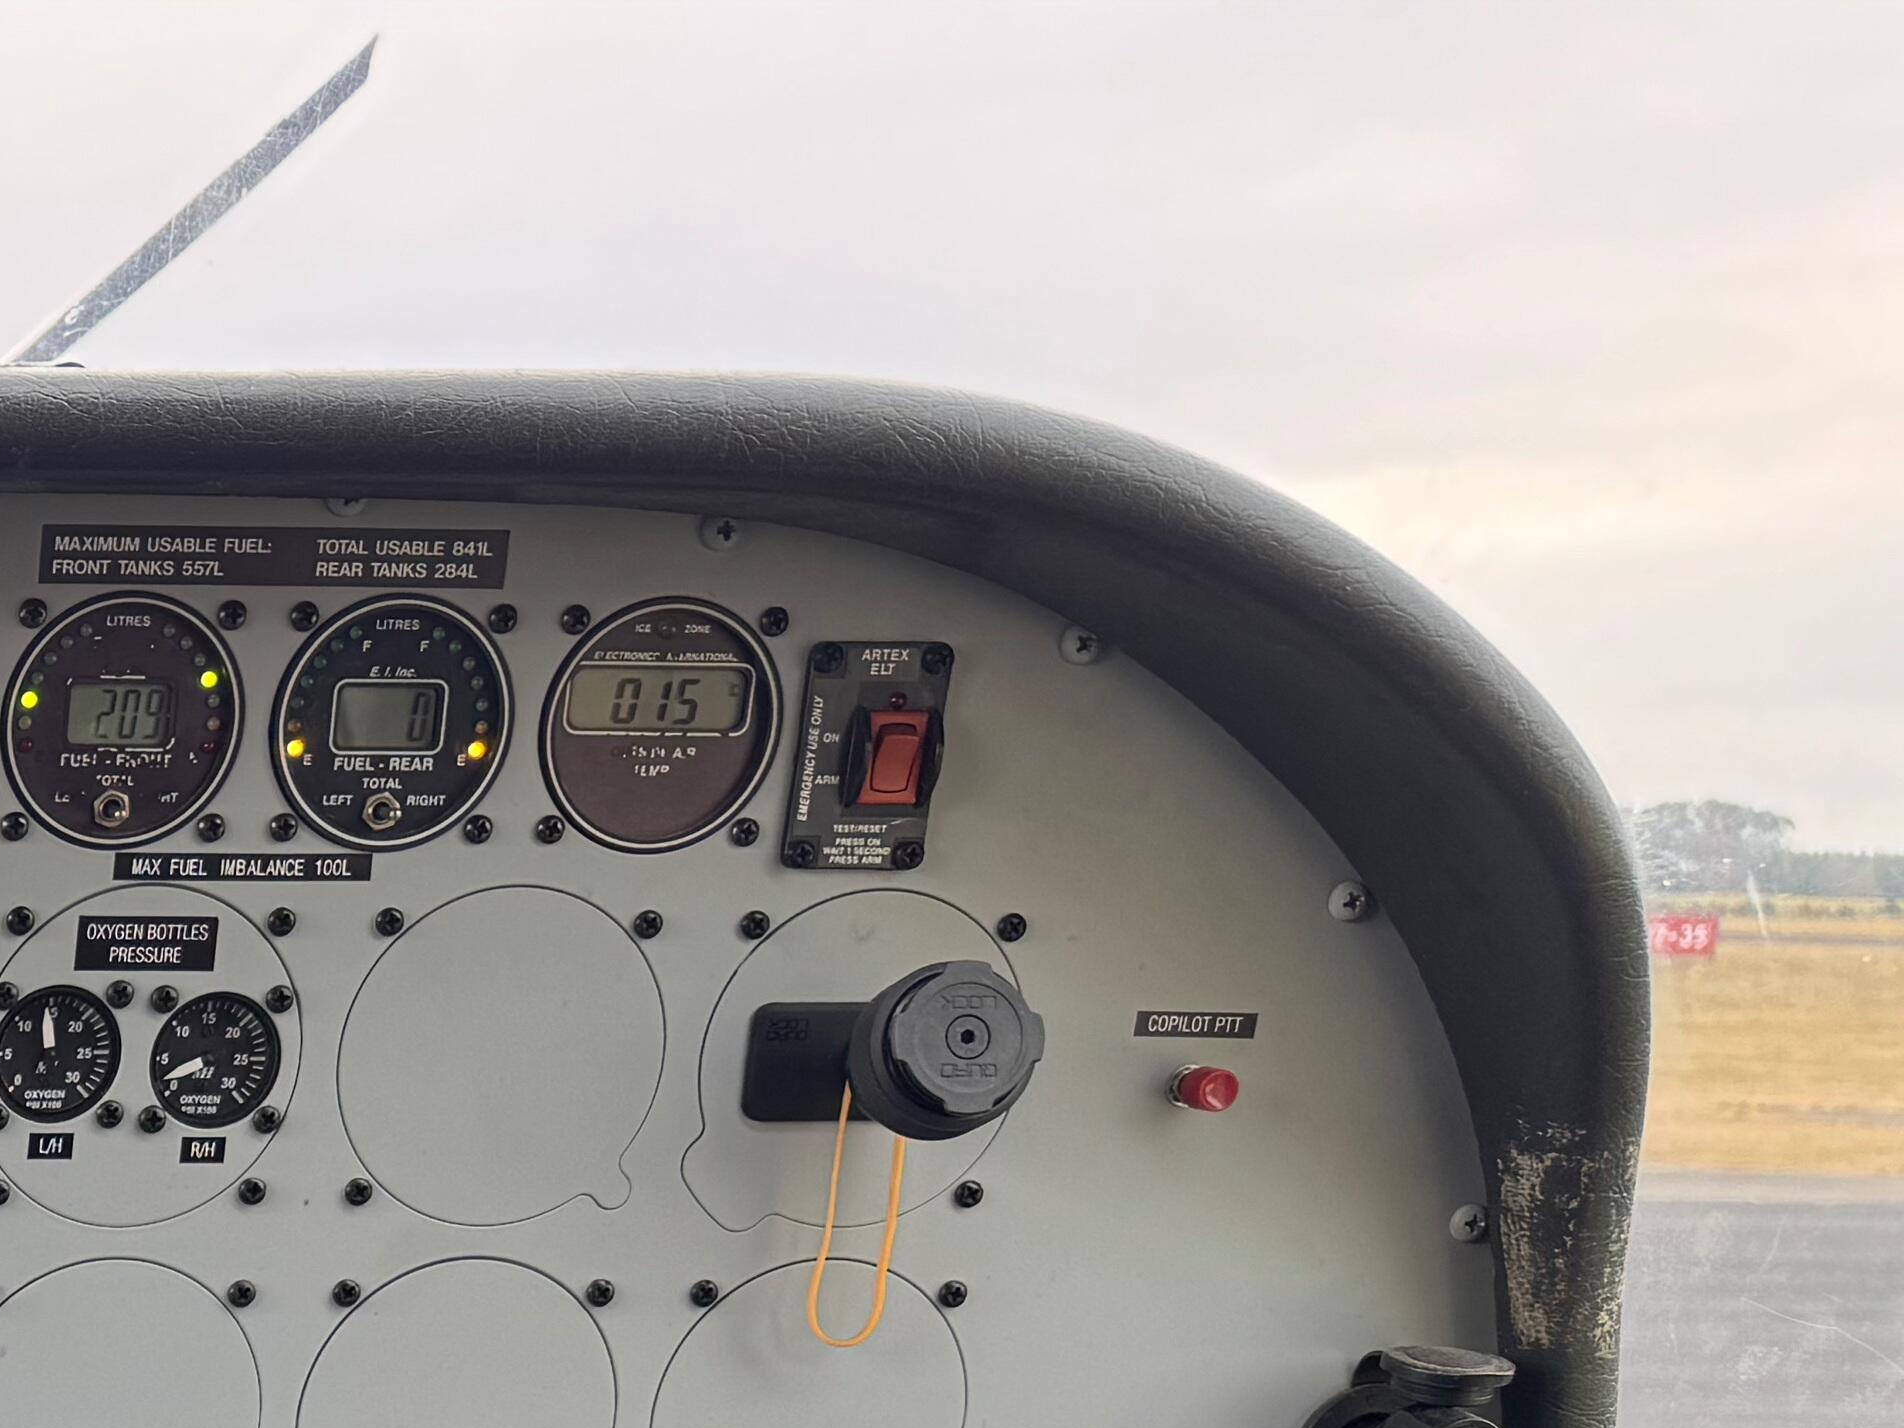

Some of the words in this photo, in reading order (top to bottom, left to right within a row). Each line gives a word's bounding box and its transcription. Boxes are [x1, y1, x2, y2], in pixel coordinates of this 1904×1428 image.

[55, 537, 140, 552] MAXIMUM
[148, 538, 218, 553] USABLE
[224, 538, 272, 554] FUEL:
[317, 540, 369, 555] TOTAL
[376, 541, 445, 556] USABLE
[452, 542, 492, 557] 841L
[52, 560, 114, 575] FRONT
[119, 560, 175, 576] TANKS
[182, 561, 224, 576] 557L
[316, 562, 364, 578] REAR
[372, 563, 427, 578] TANKS
[435, 564, 478, 579] 284L
[862, 649, 909, 661] ARTEX
[870, 663, 895, 675] ELT
[131, 860, 161, 876] MAX
[170, 860, 207, 876] FUEL
[220, 860, 304, 877] IMBALANCE
[315, 860, 351, 876] 100L
[87, 924, 143, 940] OXYGEN
[147, 925, 208, 941] BOTTLES
[109, 947, 181, 963] PRESSURE
[1148, 1015, 1211, 1033] COPILOT
[1214, 1017, 1242, 1033] PTT
[39, 1138, 63, 1154] L/H
[191, 1141, 215, 1158] R/H
